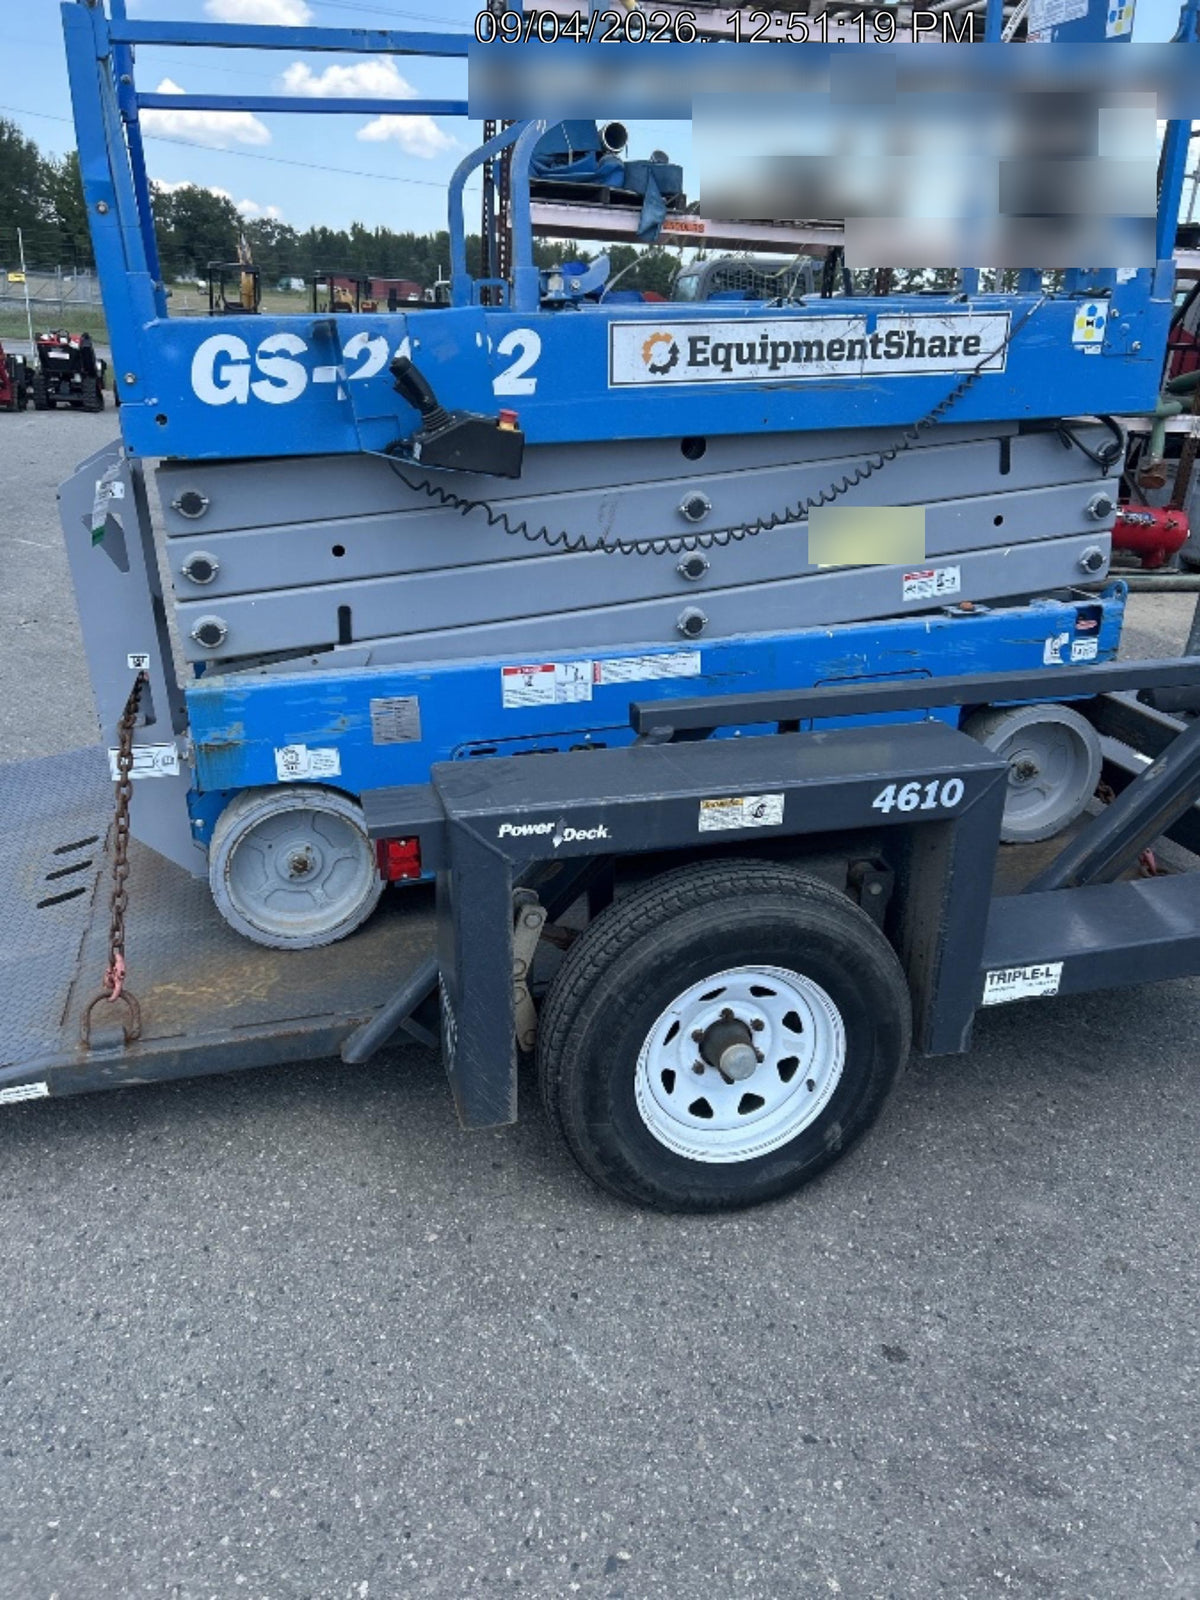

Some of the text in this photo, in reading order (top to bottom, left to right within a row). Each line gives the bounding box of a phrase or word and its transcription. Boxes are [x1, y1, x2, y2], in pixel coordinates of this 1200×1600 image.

[191, 328, 541, 405] GS-22
[687, 330, 981, 372] EquipmentShare
[872, 778, 965, 813] 4610
[498, 823, 609, 841] Power Deck
